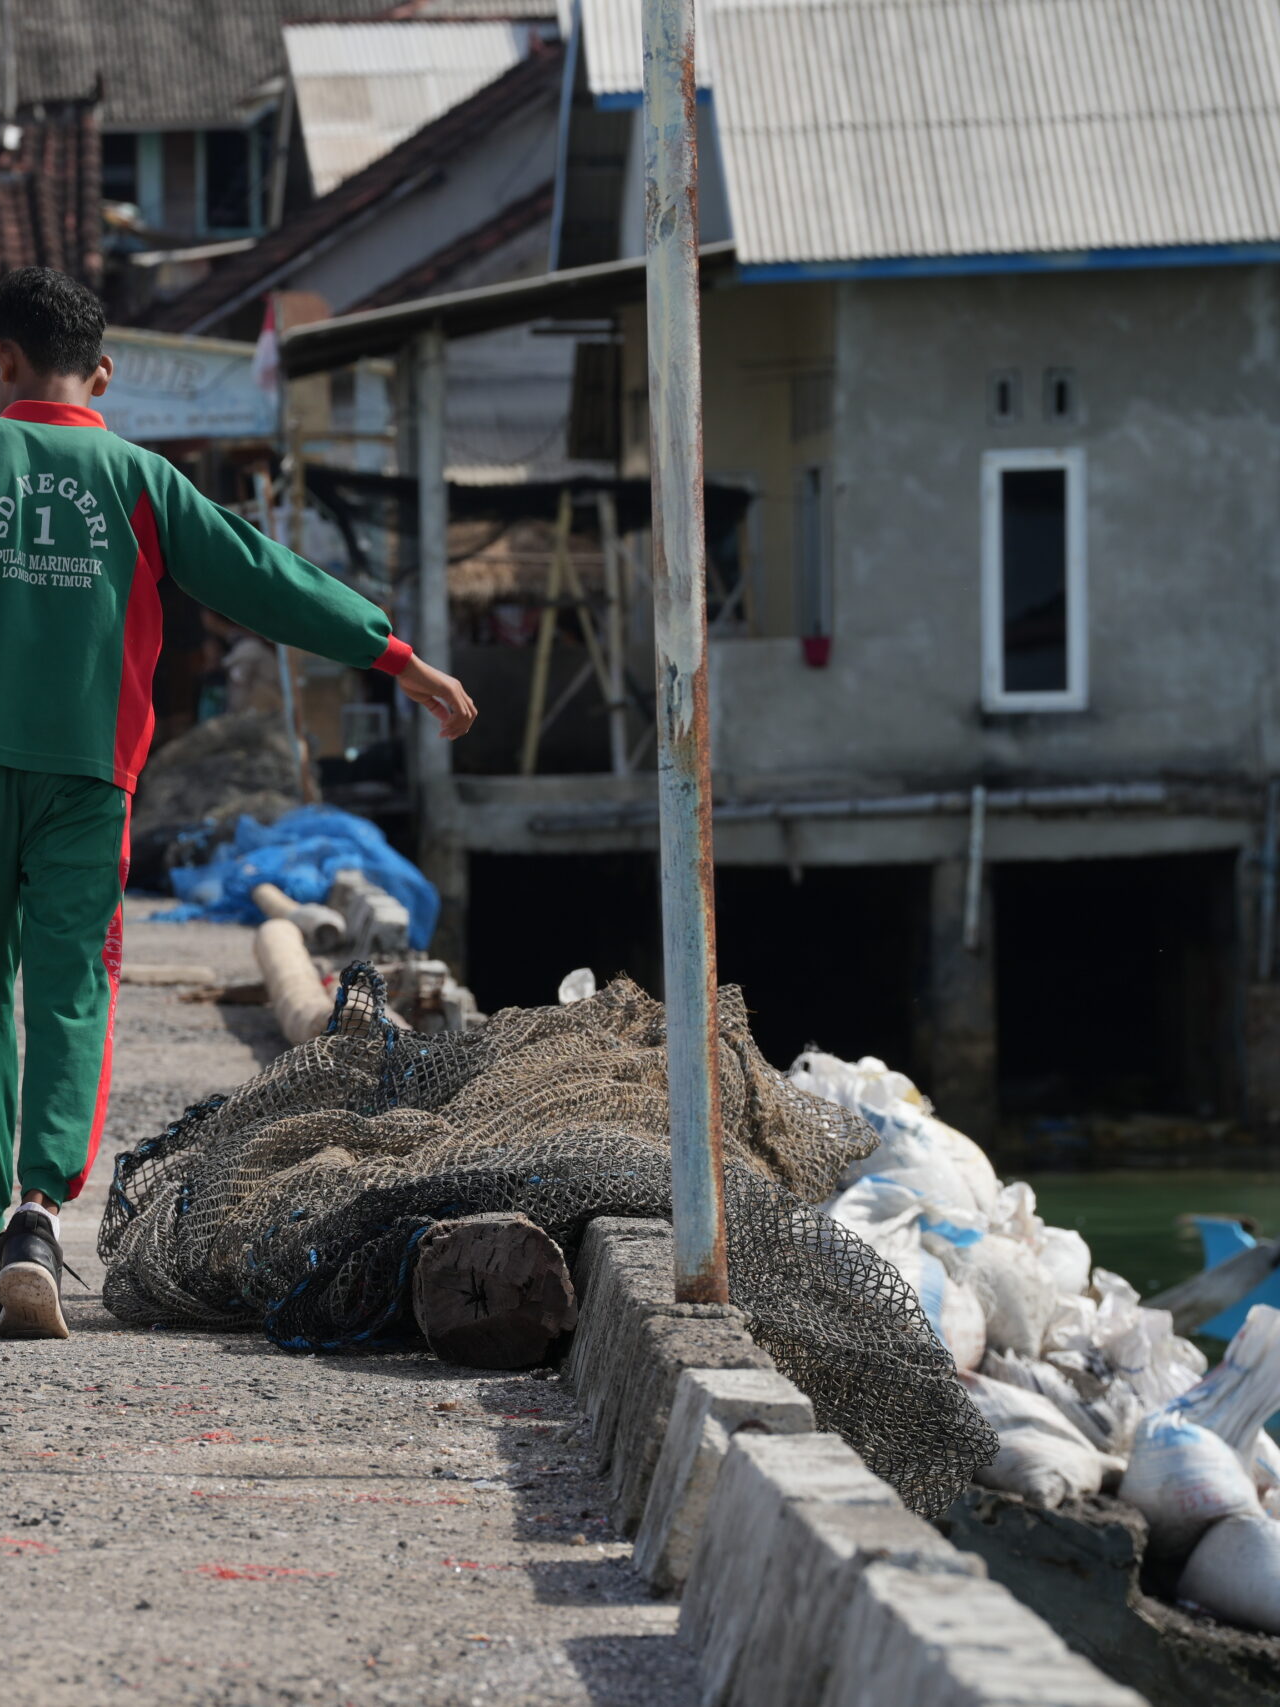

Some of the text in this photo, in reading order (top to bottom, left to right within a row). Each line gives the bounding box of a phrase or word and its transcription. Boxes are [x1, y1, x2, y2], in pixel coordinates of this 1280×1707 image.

[16, 473, 108, 549] NEGERI
[33, 506, 55, 545] 1
[2, 566, 92, 588] LOMBOK TIMUR
[29, 555, 102, 575] MARINGKIK
